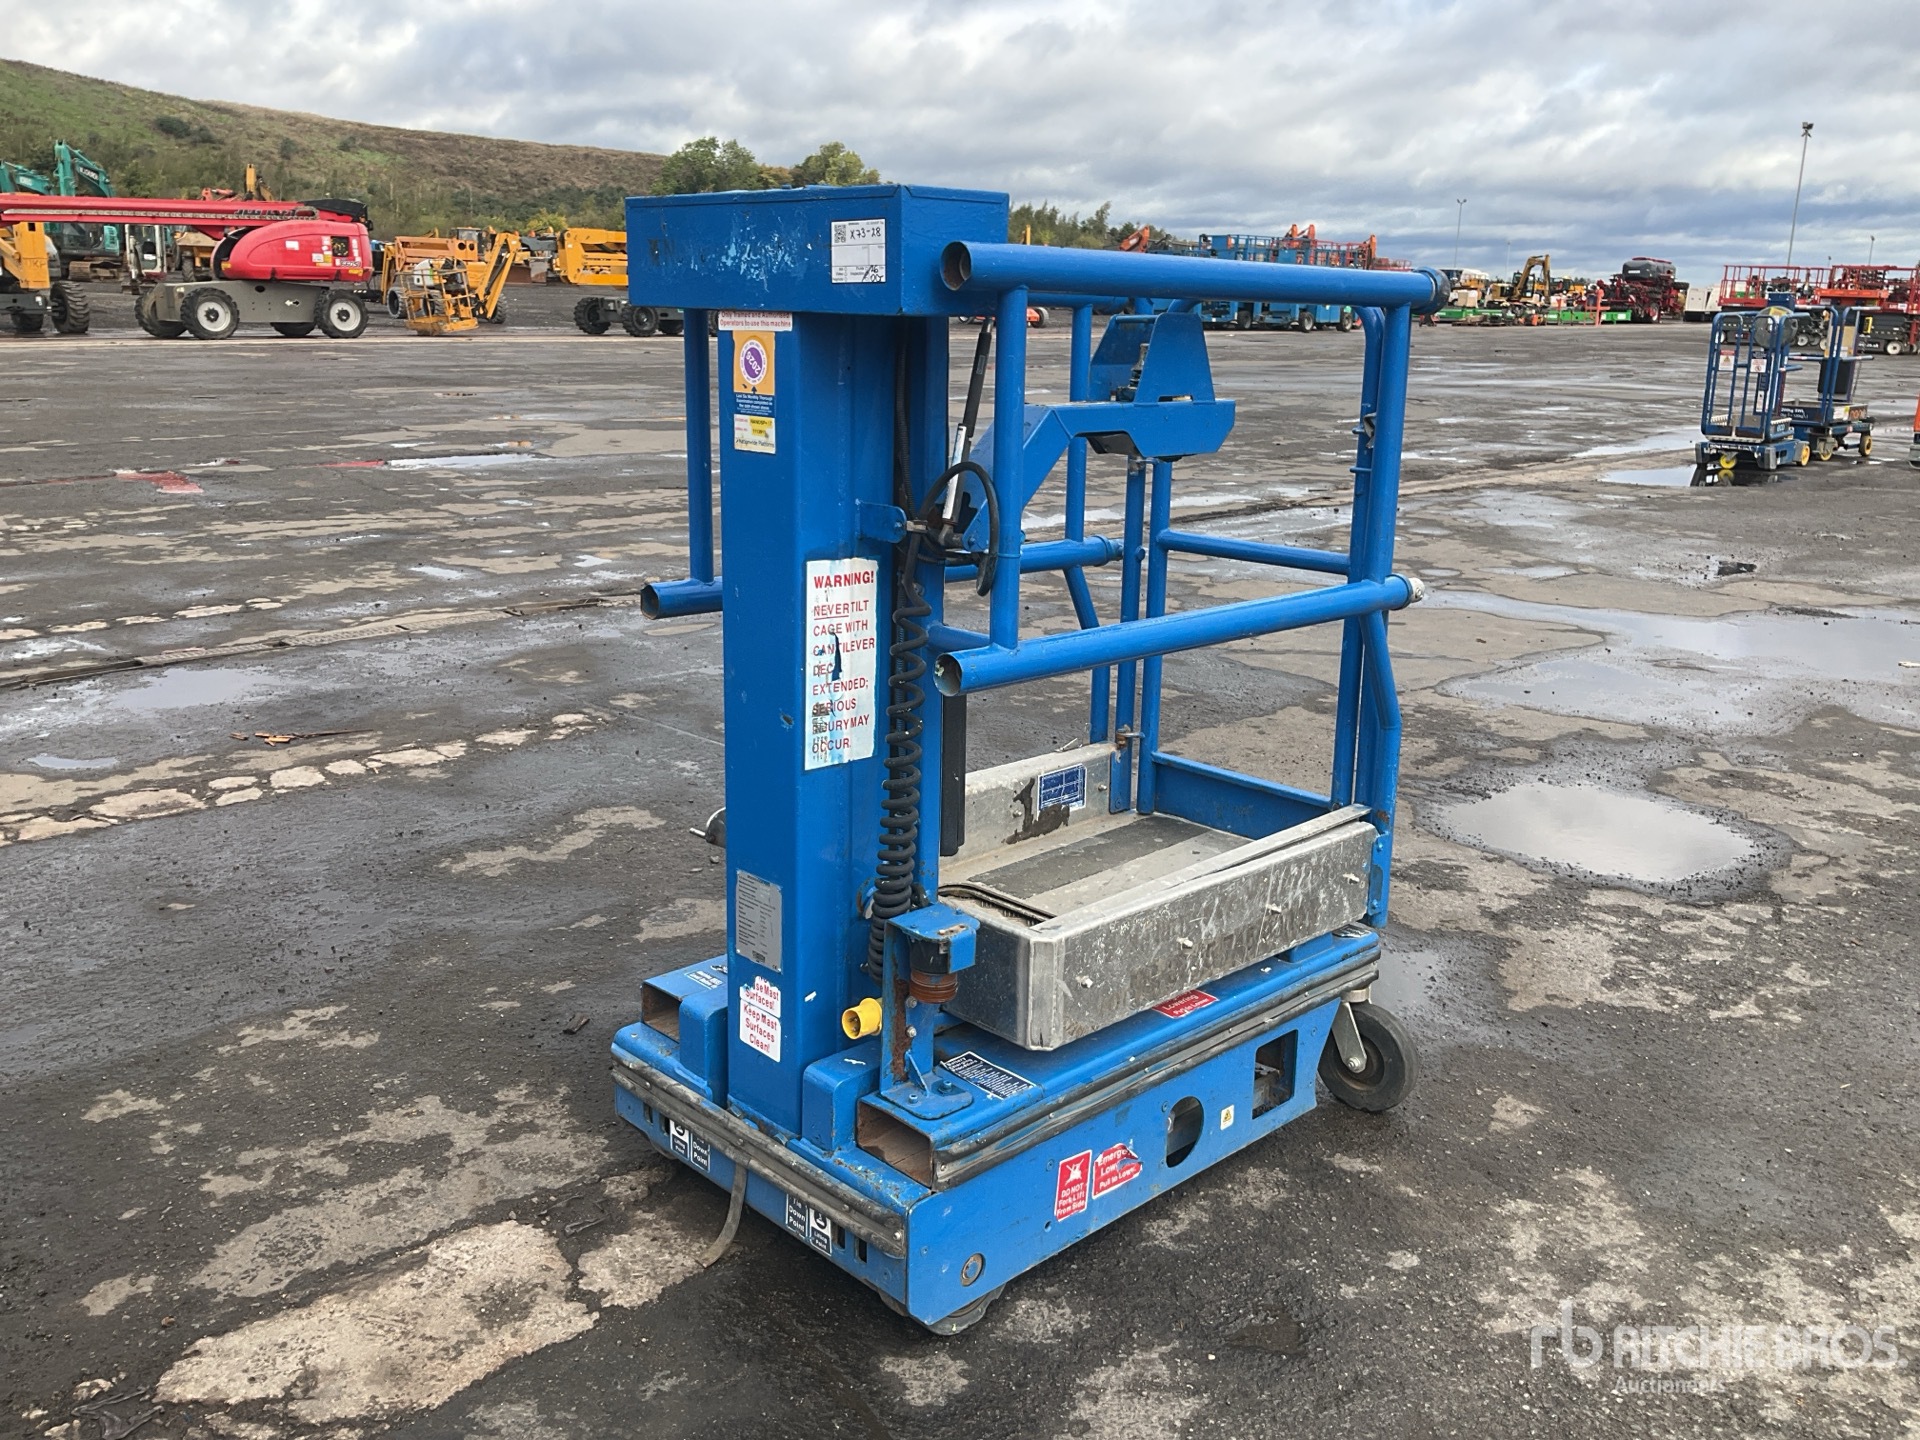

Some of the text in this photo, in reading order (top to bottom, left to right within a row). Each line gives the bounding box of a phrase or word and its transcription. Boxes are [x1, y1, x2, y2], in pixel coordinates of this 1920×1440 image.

[720, 319, 744, 327] Operators
[814, 571, 874, 589] WARNING!
[813, 600, 869, 617] NEVER TILT
[813, 619, 868, 636] CAGE WITH
[813, 637, 875, 656] CANILEVER
[812, 677, 869, 695] EXTENDED;
[812, 698, 857, 716] SERIOUS
[850, 714, 870, 729] MAY
[745, 988, 774, 1010] Surfaces!
[764, 985, 779, 1001] Mast
[743, 1003, 777, 1031] Keep Mast
[745, 1017, 775, 1042] Surfaces
[749, 1033, 770, 1053] Clean!
[693, 1141, 708, 1155] Down
[693, 1151, 708, 1166] Point
[1061, 1182, 1085, 1198] DO NOT
[1099, 1179, 1111, 1189] Pull
[1111, 1175, 1118, 1183] to
[1058, 1190, 1085, 1207] Fork Lift
[788, 1205, 806, 1222] Down
[1057, 1200, 1085, 1216] From Side
[789, 1216, 805, 1232] Point
